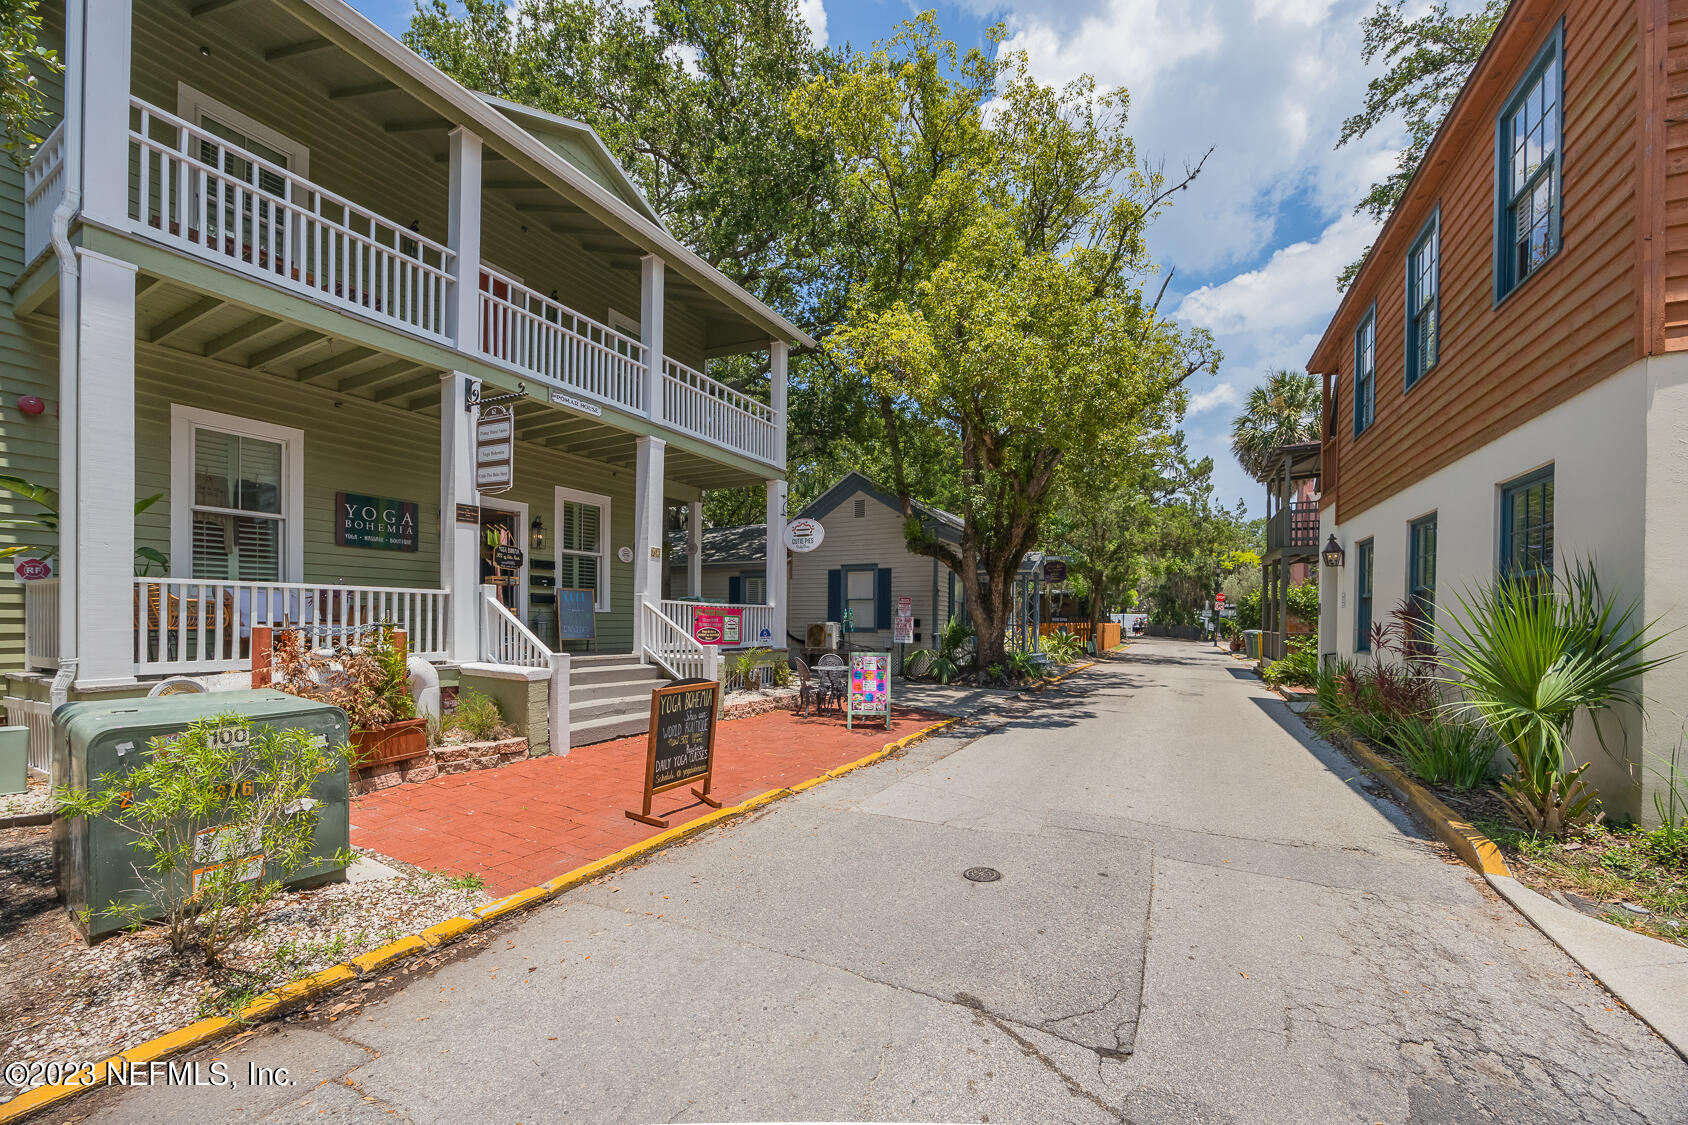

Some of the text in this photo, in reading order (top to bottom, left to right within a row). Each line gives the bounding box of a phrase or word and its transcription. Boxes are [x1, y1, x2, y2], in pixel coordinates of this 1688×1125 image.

[344, 503, 414, 526] YOGA
[345, 519, 413, 535] BOHEMIA
[661, 690, 712, 715] YOGA BOHEMIA
[662, 717, 709, 740] WORLD BOUTIQUE
[655, 749, 708, 773] DAILY YOGA CLASSES
